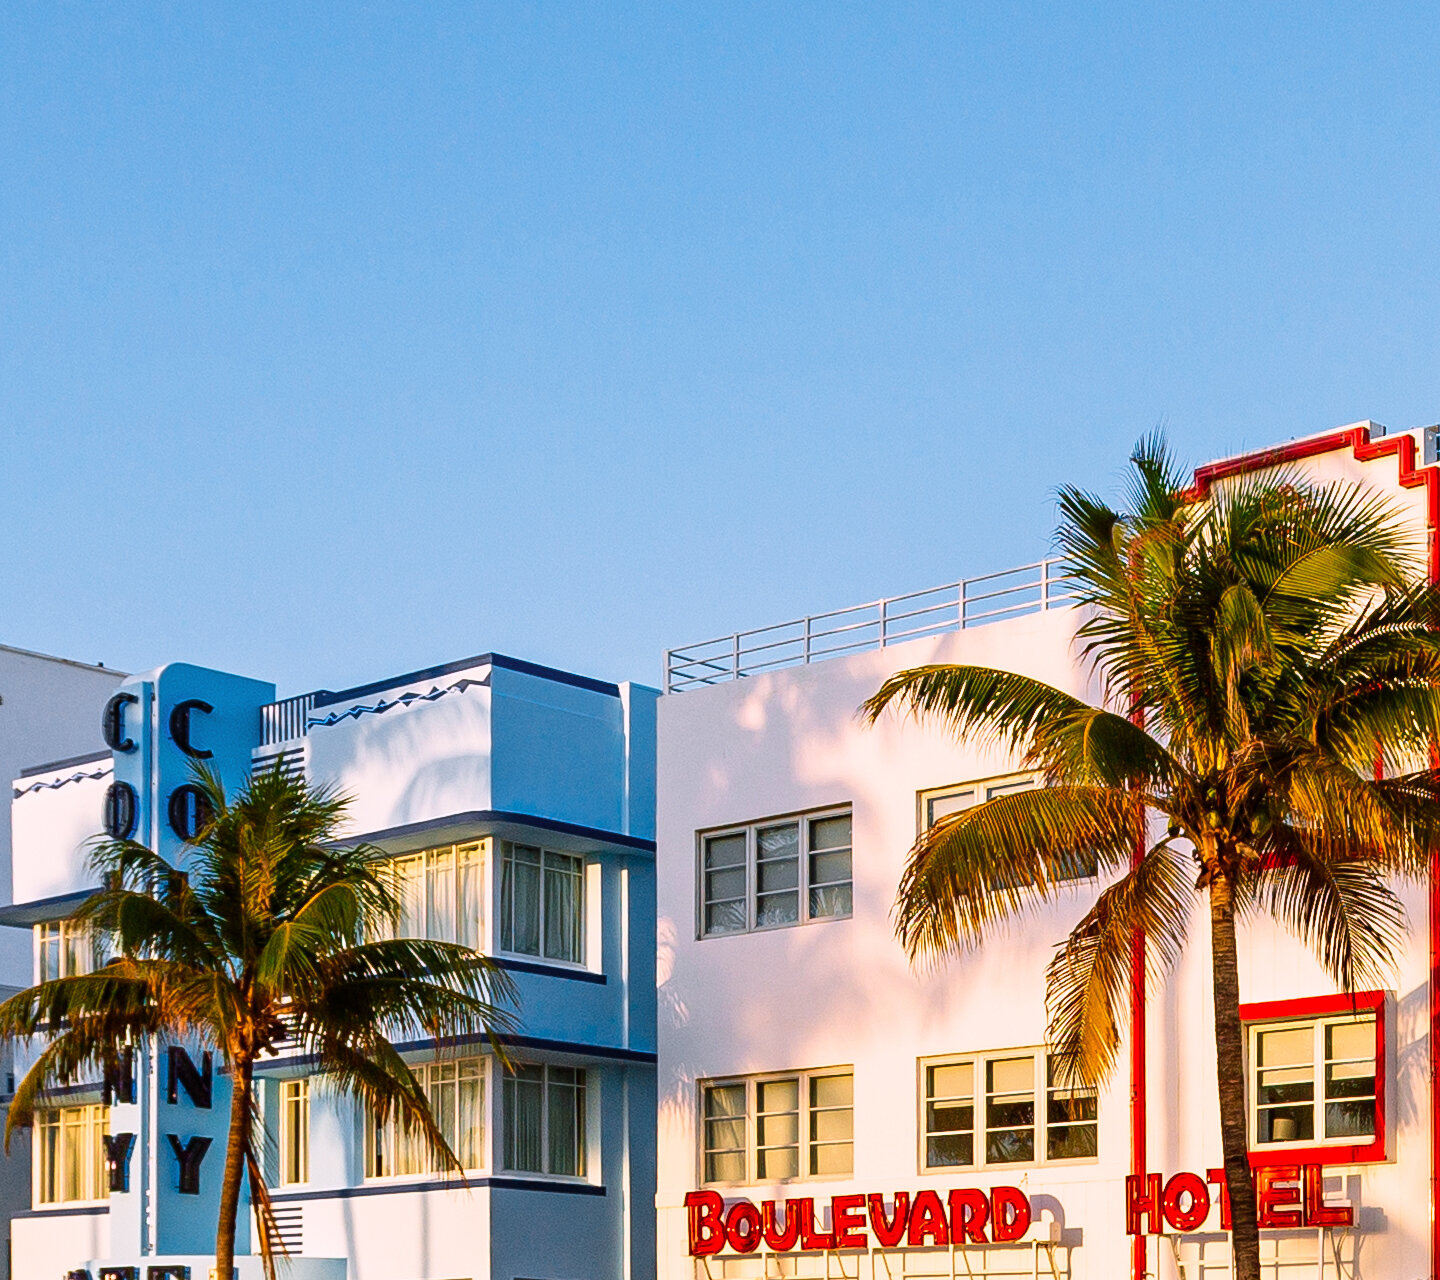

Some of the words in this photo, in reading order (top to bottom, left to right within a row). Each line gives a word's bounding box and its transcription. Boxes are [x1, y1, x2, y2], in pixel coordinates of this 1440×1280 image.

[102, 692, 139, 1194] CONY
[165, 698, 214, 1196] CONY
[685, 1186, 1031, 1256] BOULEVARD
[1126, 1163, 1354, 1235] HOTEL
